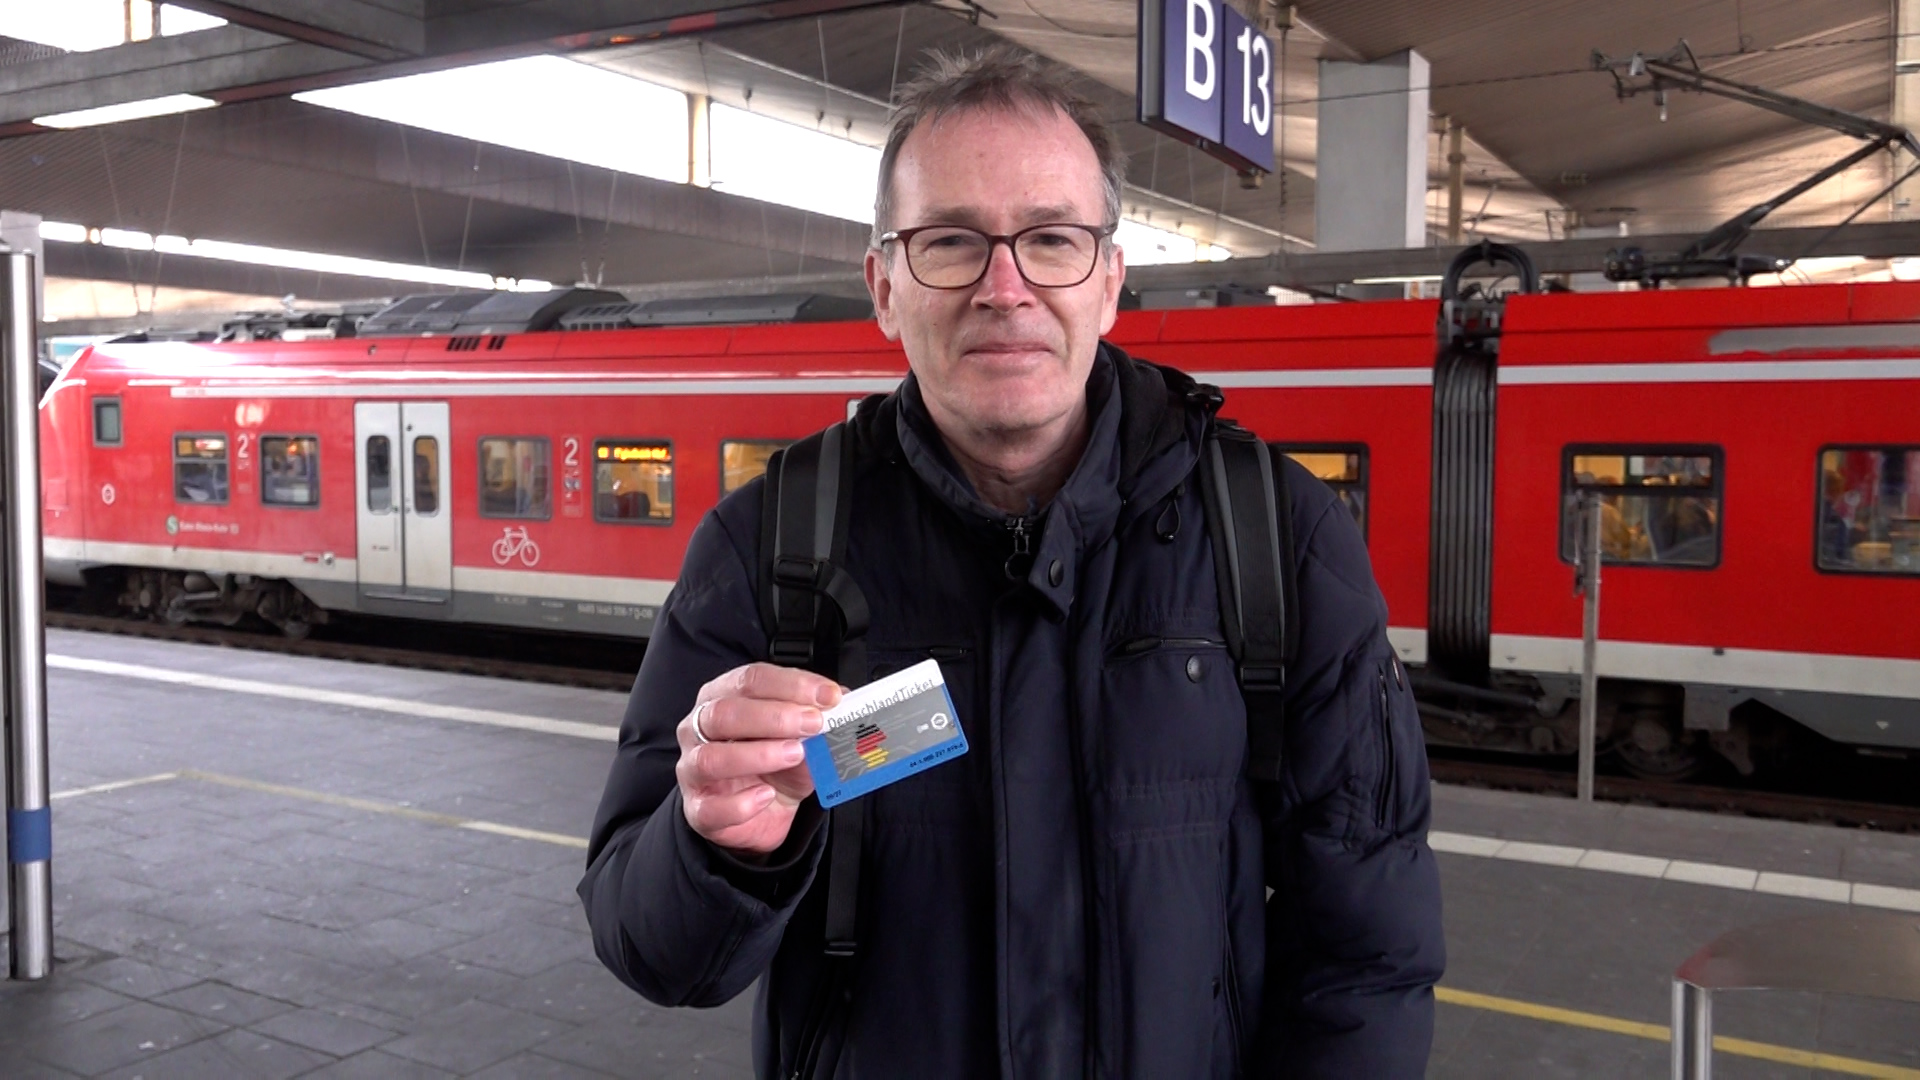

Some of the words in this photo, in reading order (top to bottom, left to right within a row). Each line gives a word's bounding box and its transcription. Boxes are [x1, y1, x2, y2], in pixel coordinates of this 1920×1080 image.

[1185, 0, 1216, 100] B
[1237, 26, 1271, 136] 13
[237, 433, 249, 458] 2
[564, 438, 578, 466] 2
[827, 678, 936, 731] DeutschlandTicket
